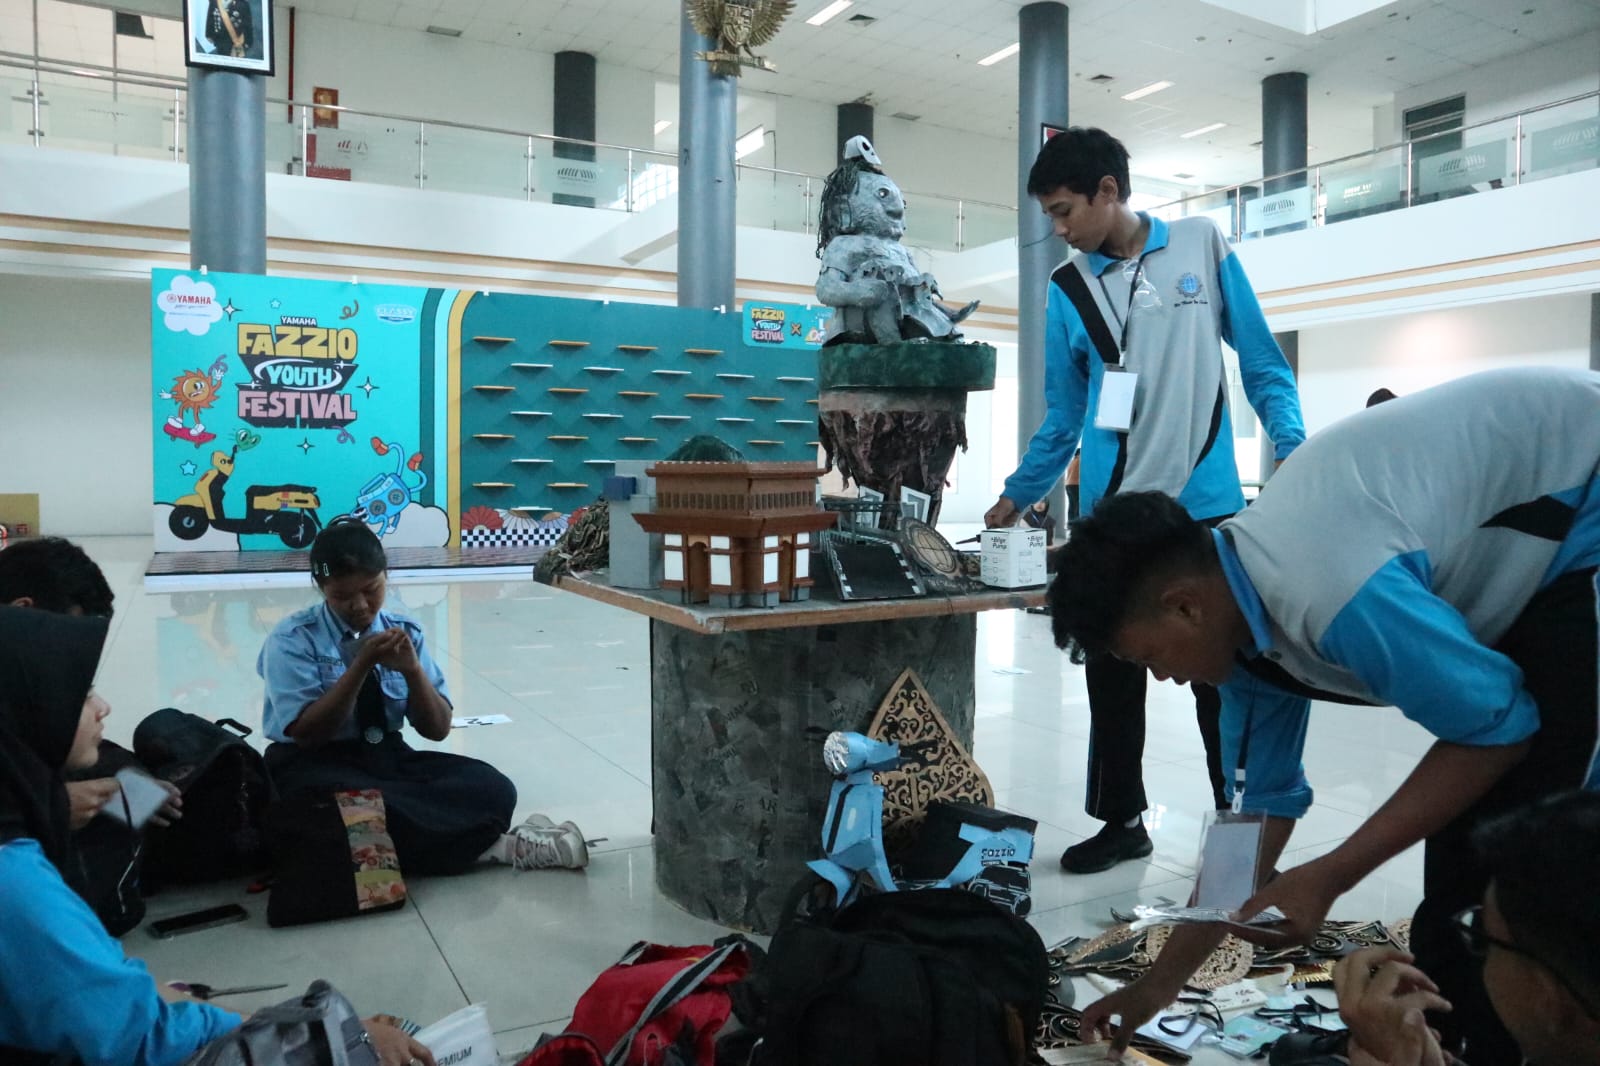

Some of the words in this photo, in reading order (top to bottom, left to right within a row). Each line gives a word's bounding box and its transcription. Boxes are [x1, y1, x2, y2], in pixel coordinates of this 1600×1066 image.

[177, 295, 212, 305] YAMAHA
[752, 309, 785, 320] FAZZIO
[281, 316, 317, 326] YAMAHA
[752, 331, 785, 340] FESTIVAL
[239, 324, 357, 359] FAZZIO
[265, 365, 332, 386] YOUTH
[239, 391, 357, 419] FESTIVAL
